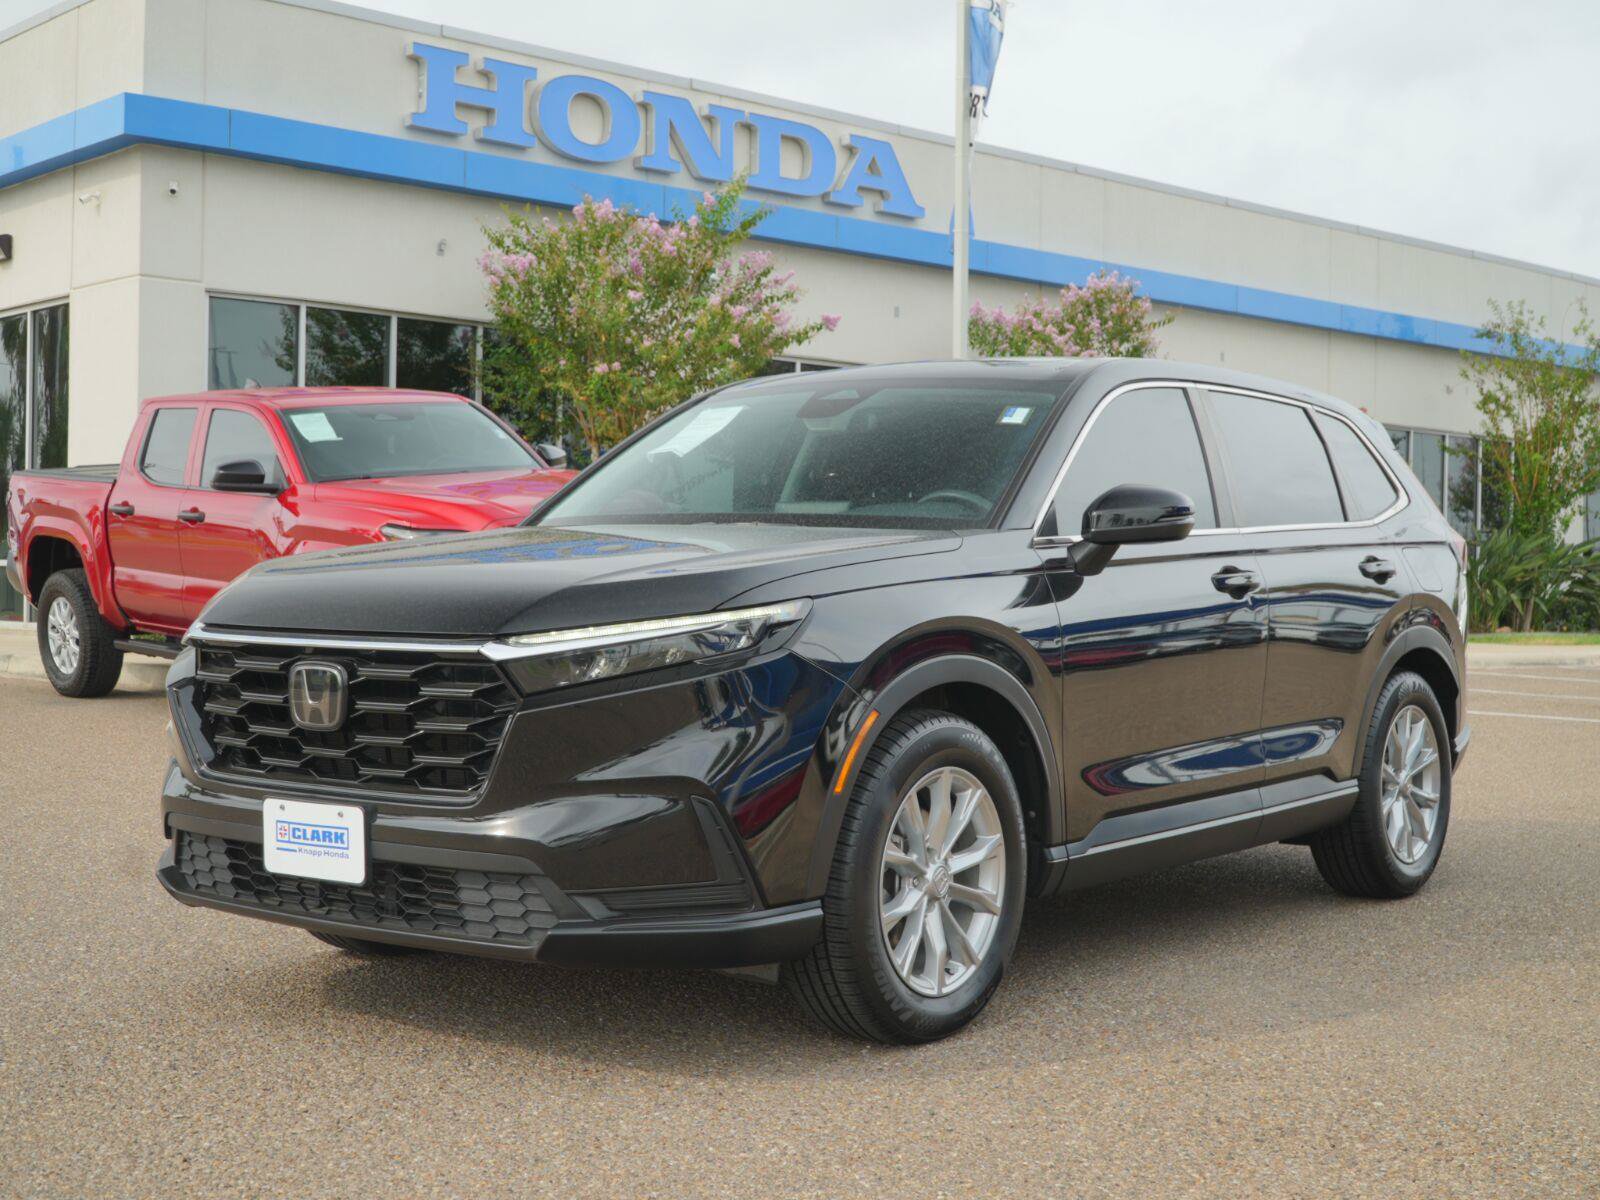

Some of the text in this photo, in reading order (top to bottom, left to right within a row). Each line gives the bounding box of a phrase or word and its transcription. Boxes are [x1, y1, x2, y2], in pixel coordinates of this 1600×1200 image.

[405, 42, 925, 219] HONDA
[292, 827, 345, 845] CLARK
[297, 847, 350, 859] Knapp Honda
